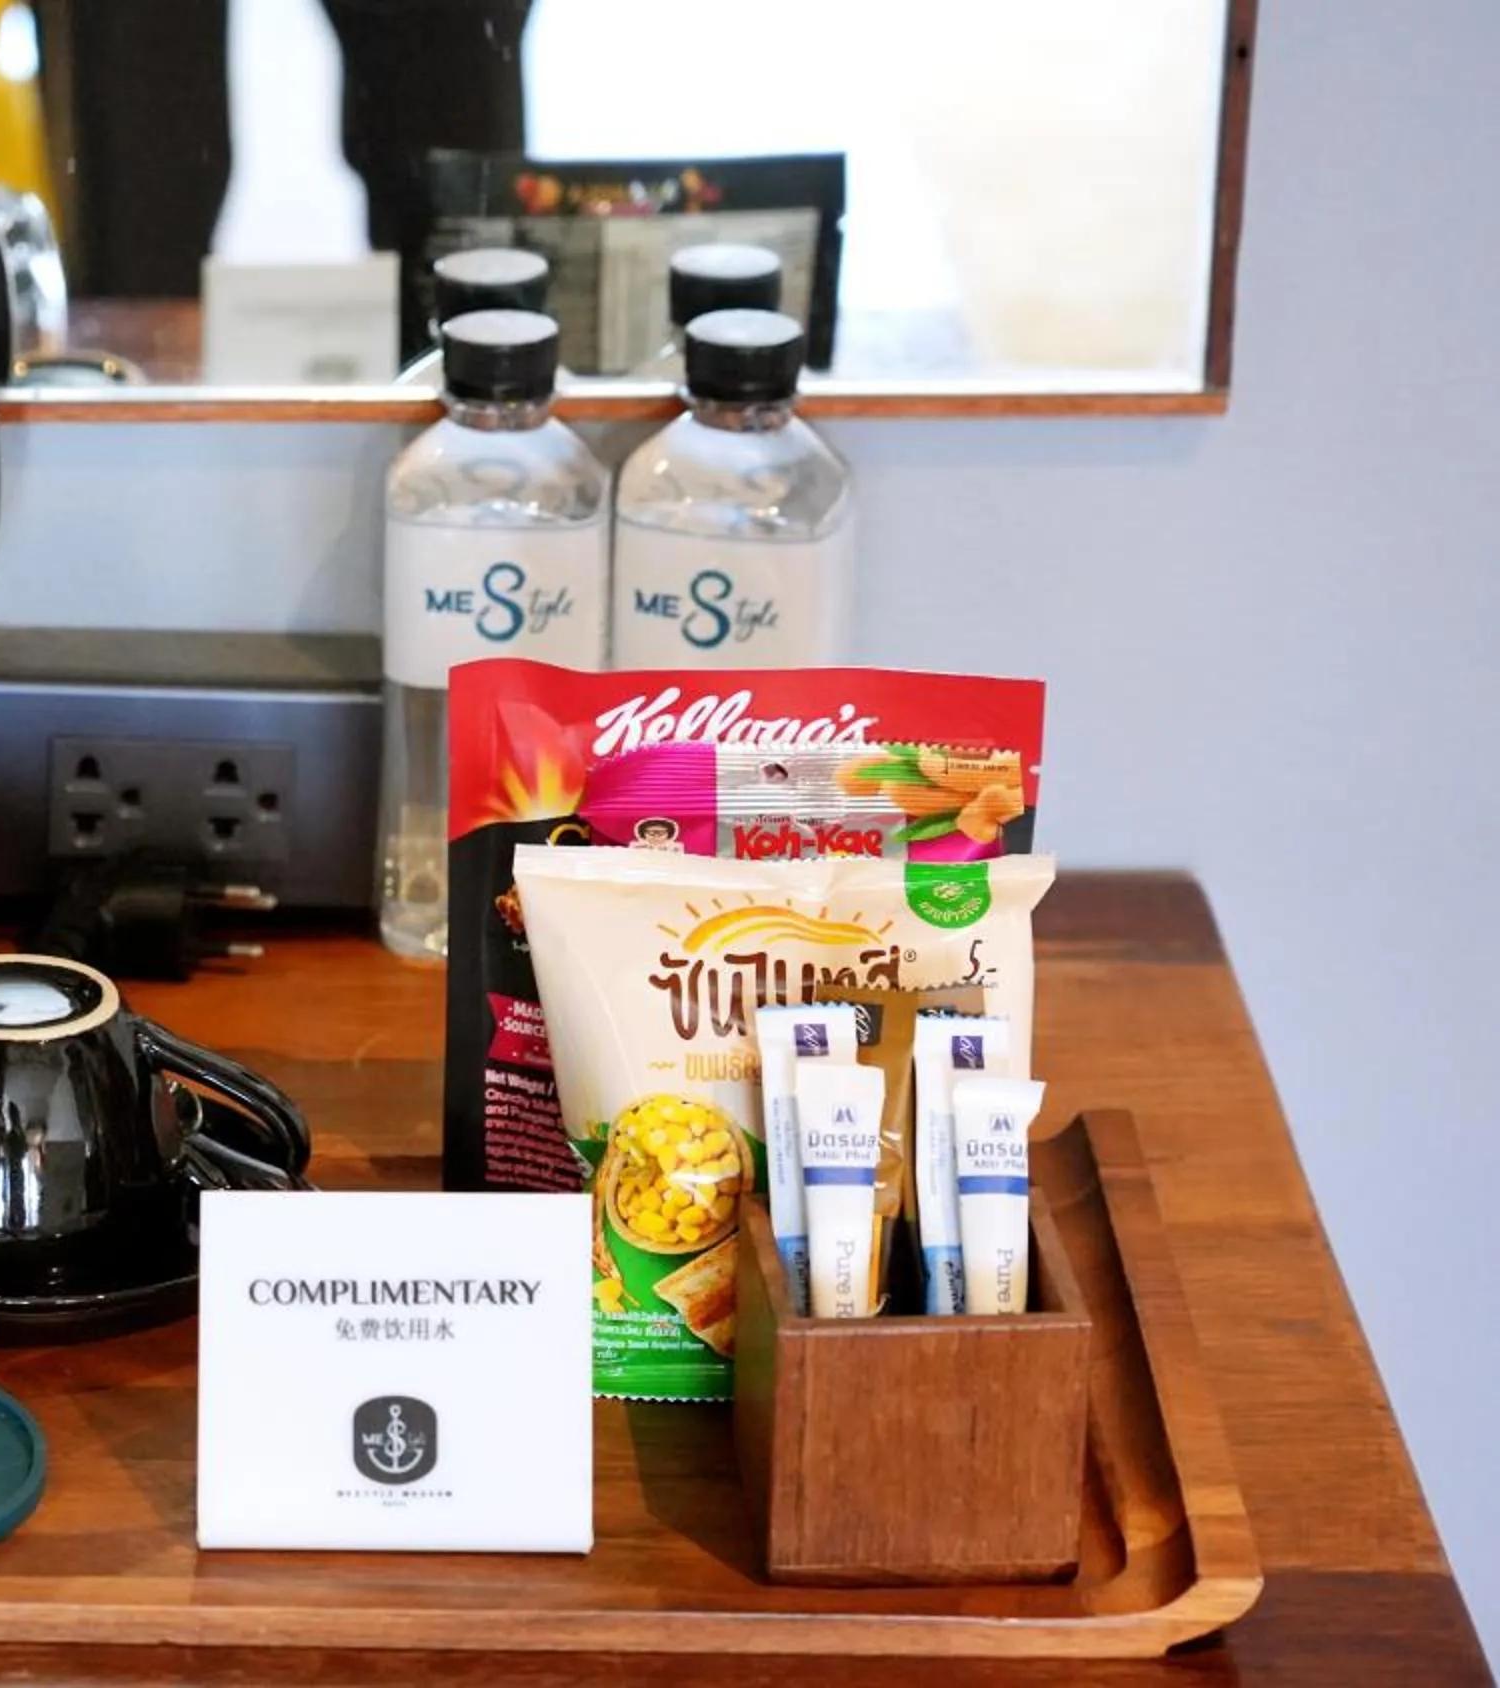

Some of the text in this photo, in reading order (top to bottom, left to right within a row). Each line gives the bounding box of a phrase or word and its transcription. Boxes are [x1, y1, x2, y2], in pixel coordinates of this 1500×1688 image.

[425, 588, 474, 614] ME
[634, 590, 680, 618] ME
[733, 823, 883, 860] Koh-Kae
[513, 1001, 545, 1020] MAD
[503, 1016, 546, 1036] SOURC
[835, 1240, 855, 1295] Pure
[996, 1248, 1014, 1303] Pure
[249, 1279, 541, 1306] COMPLIMENTARY
[335, 1317, 456, 1341] 免费饮用水
